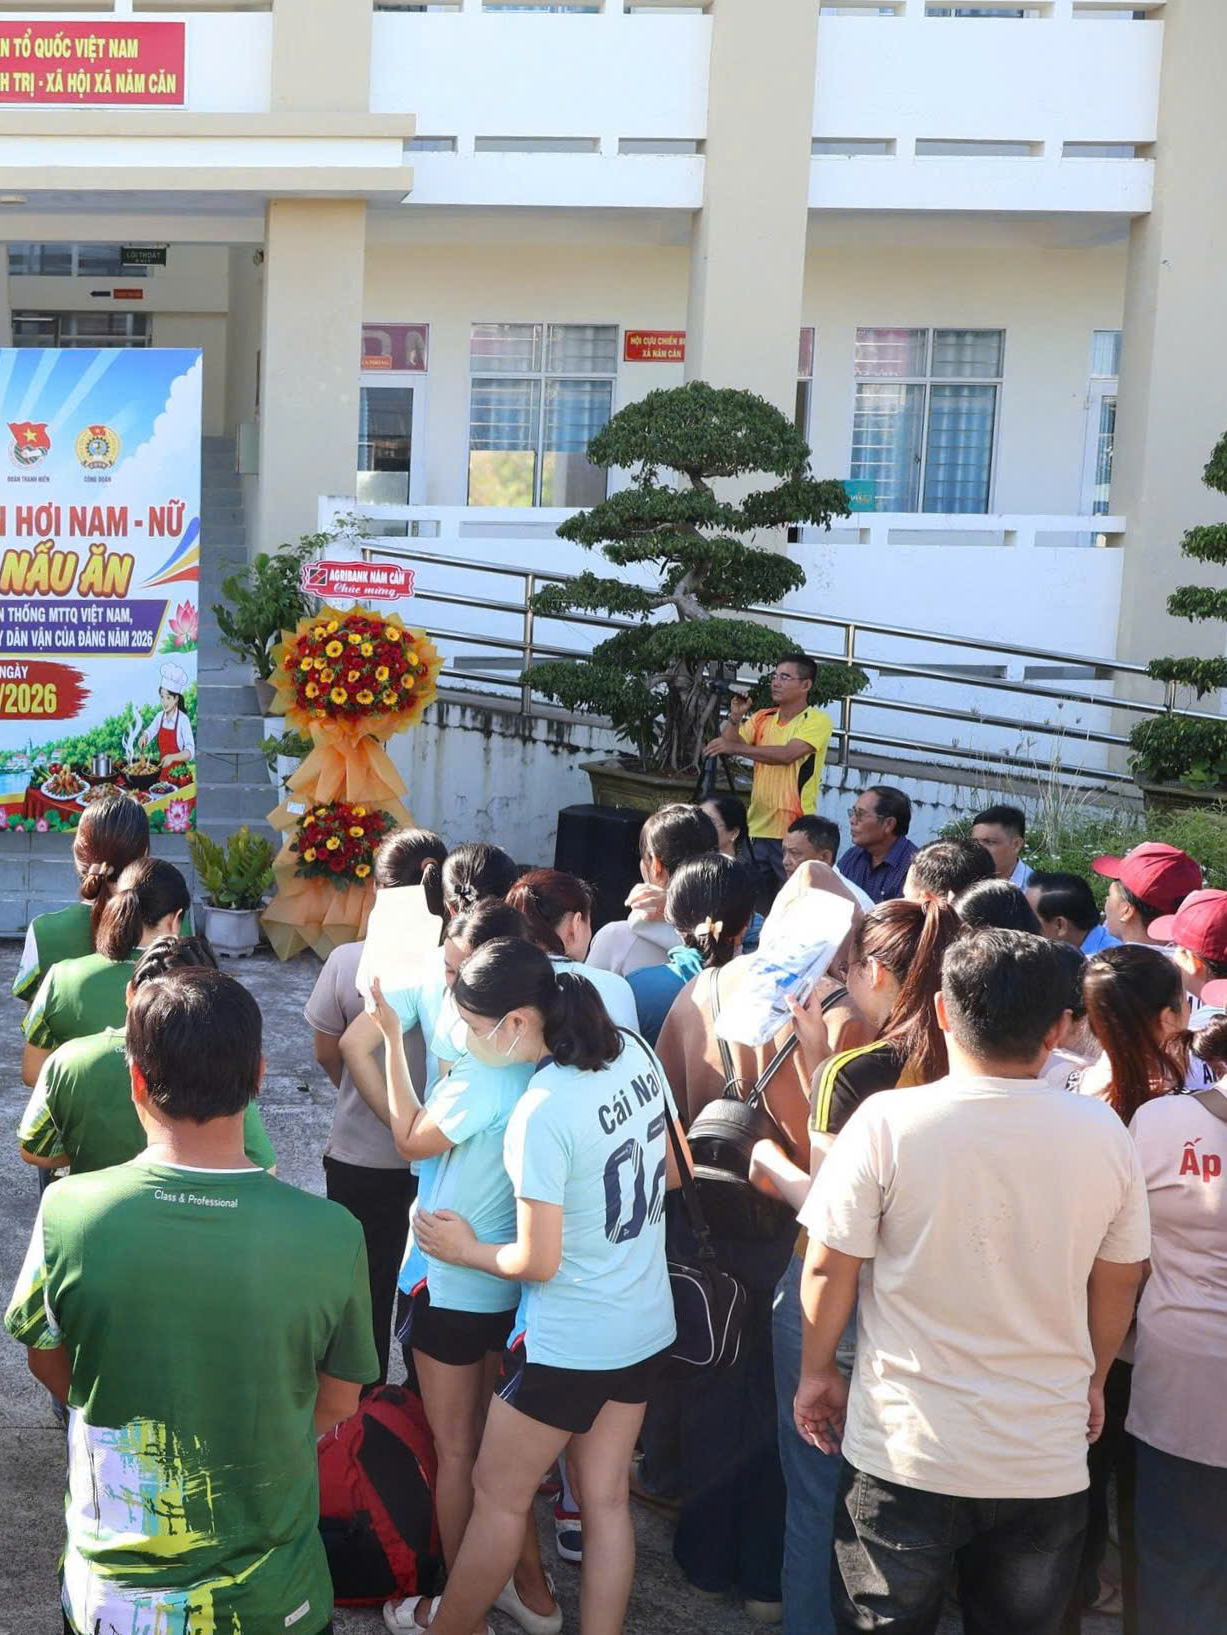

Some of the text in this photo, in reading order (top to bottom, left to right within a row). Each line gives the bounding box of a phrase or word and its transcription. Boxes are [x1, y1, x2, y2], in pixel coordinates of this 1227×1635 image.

[13, 28, 32, 58] TỔ
[34, 32, 71, 58] QUỐC
[75, 34, 105, 63] VIỆT
[109, 39, 138, 58] NAM
[13, 72, 35, 97] TRỊ
[46, 68, 66, 93] XÃ
[68, 69, 90, 98] HỘI
[94, 68, 112, 93] XÃ
[116, 69, 145, 93] NĂM
[148, 69, 176, 94] CĂN
[15, 502, 61, 537] HƠI
[69, 506, 128, 537] NAM
[148, 499, 186, 537] NỮ
[78, 543, 135, 598] ĂN
[329, 569, 369, 584] AGRIBANK
[8, 602, 46, 622] THỐNG
[81, 604, 104, 626] VIỆT
[106, 607, 133, 625] NAM,
[6, 627, 30, 647] DÂN
[32, 627, 52, 650] VẬN
[55, 626, 75, 647] CỦA
[78, 626, 105, 648] ĐẢNG
[108, 627, 129, 647] NĂM
[131, 630, 153, 648] 2026
[598, 1087, 633, 1135] Cái
[1179, 1137, 1222, 1182] Ấp
[154, 1189, 239, 1208] Class & Professional
